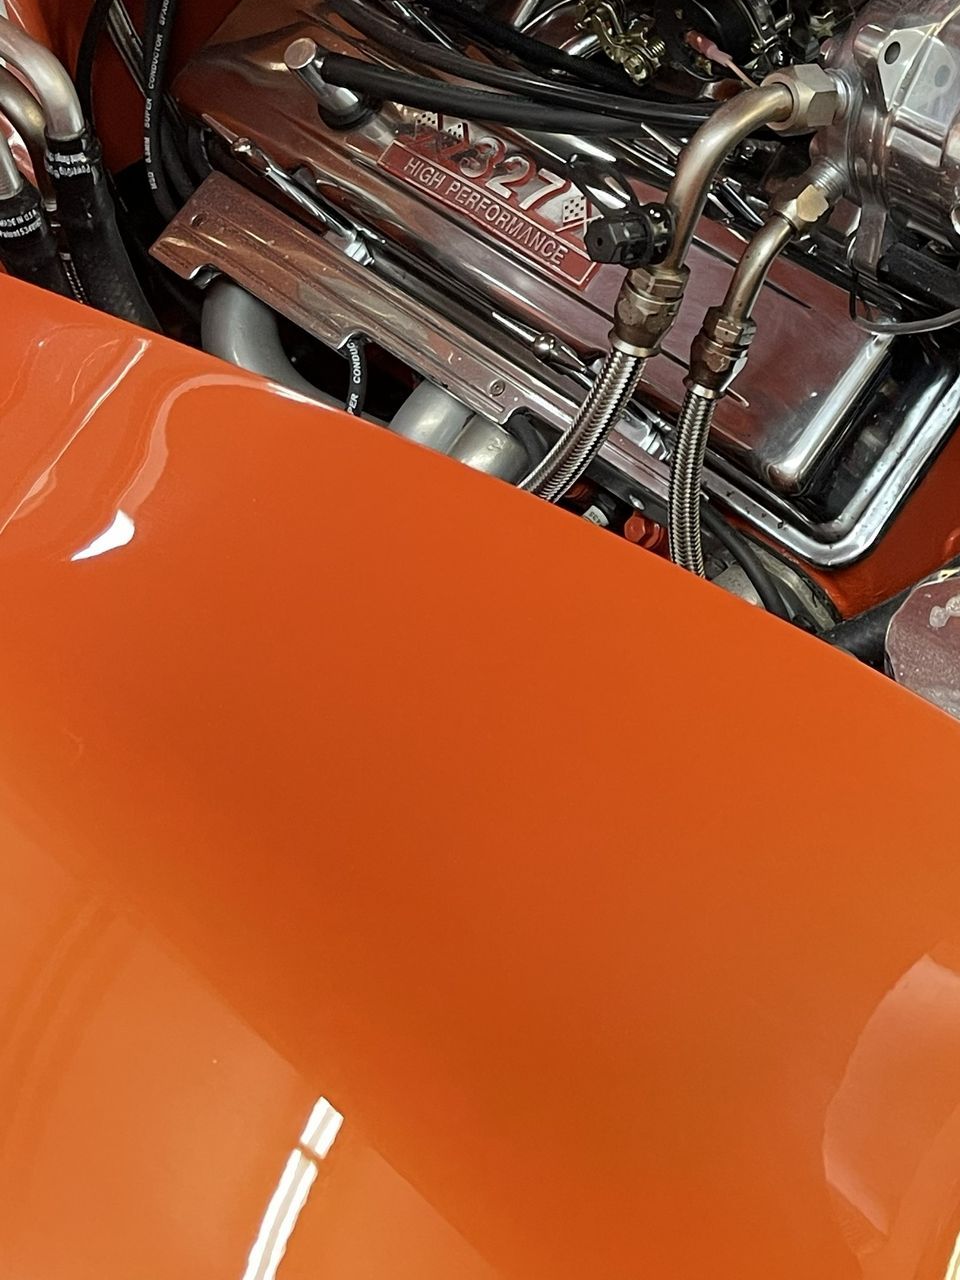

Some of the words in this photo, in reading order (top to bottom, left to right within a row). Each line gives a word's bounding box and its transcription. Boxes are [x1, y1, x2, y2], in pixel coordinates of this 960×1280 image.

[144, 97, 152, 129] SUPER
[148, 33, 163, 90] CONDUCTOR
[403, 157, 447, 191] HIGH
[447, 182, 569, 266] PERFORMANCE
[459, 136, 567, 210] 327
[346, 340, 361, 384] CONDUC
